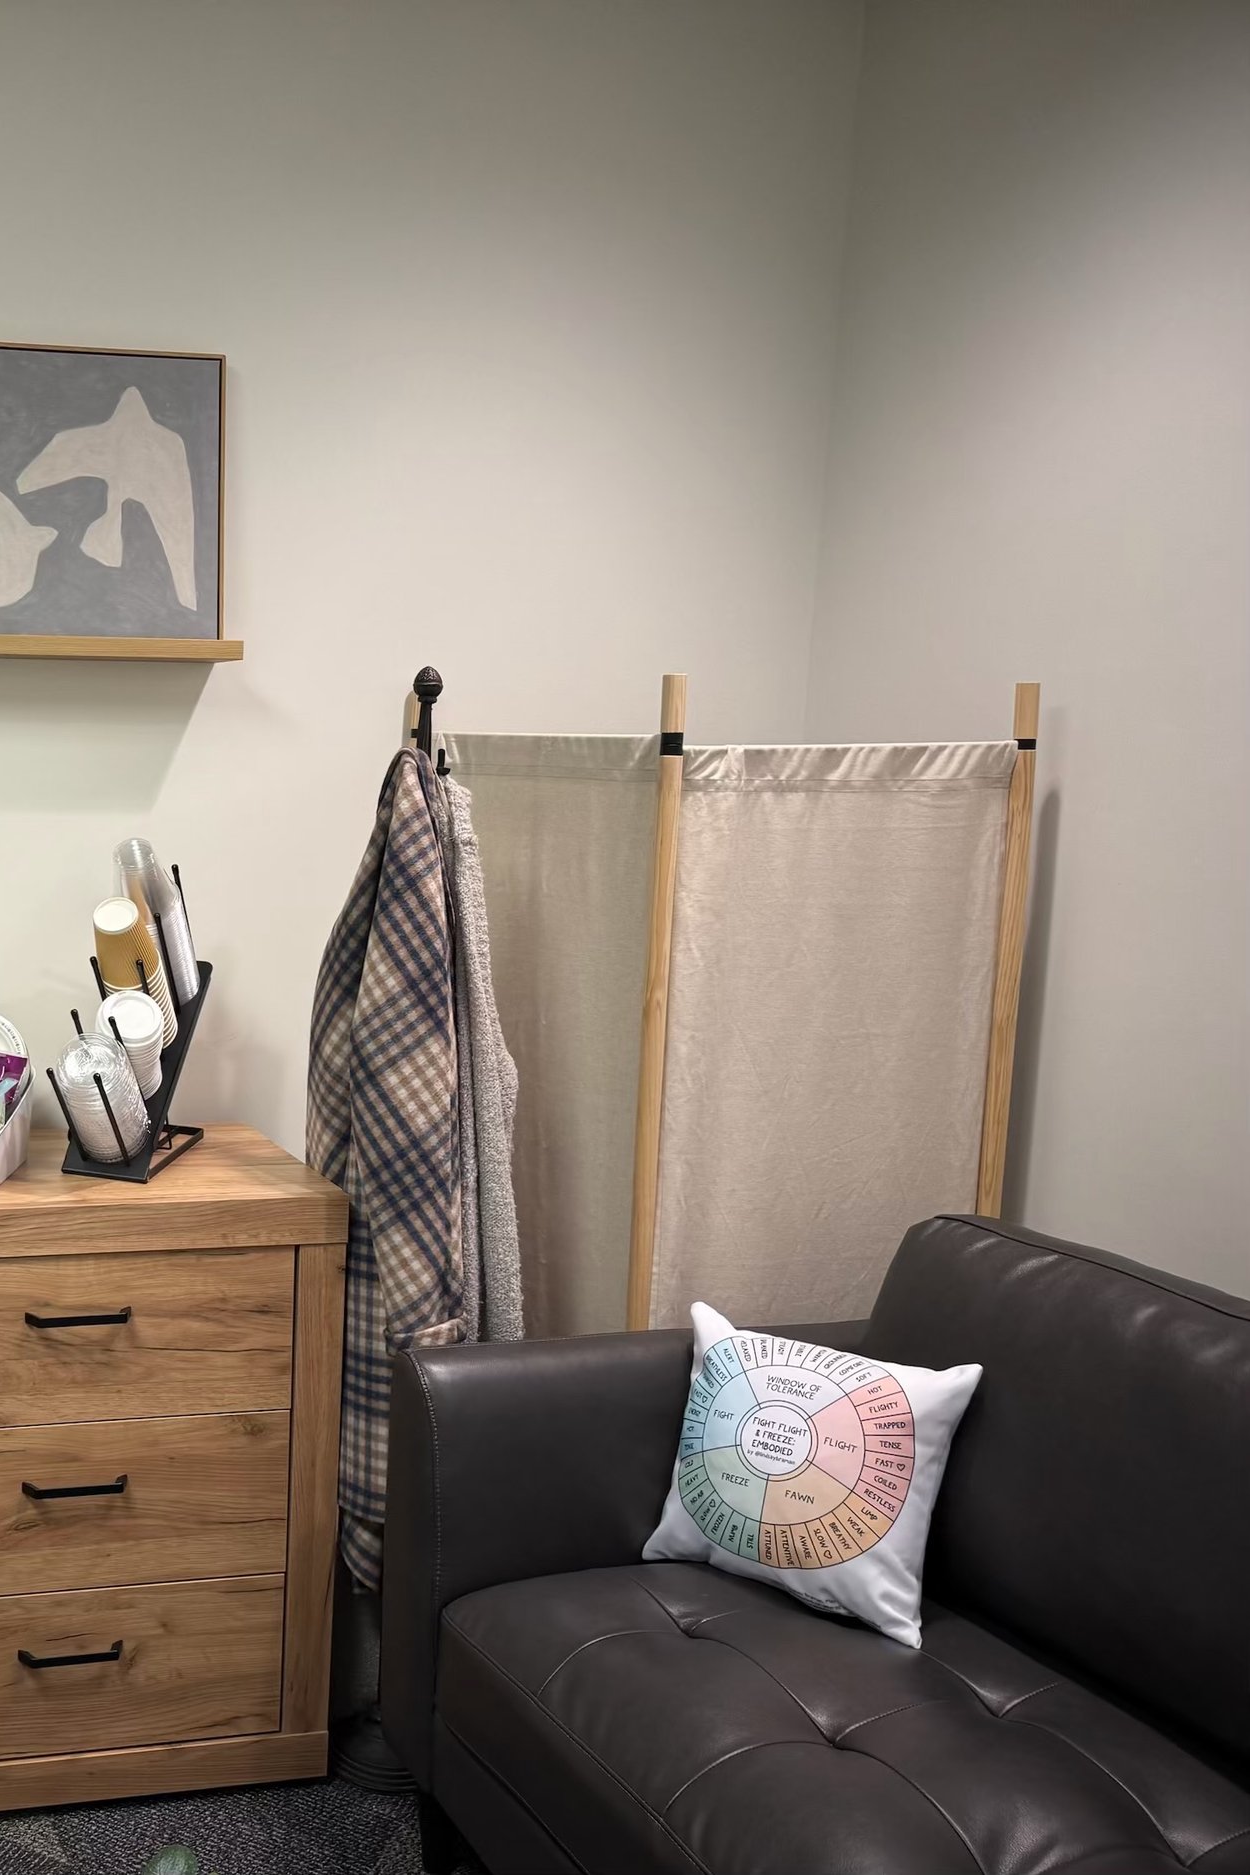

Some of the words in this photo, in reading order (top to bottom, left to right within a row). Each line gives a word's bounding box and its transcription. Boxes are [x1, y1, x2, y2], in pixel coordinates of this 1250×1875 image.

[723, 1348, 735, 1363] ALERT
[767, 1374, 808, 1389] WINDOW
[809, 1384, 823, 1393] OF
[855, 1371, 873, 1382] SOFT
[766, 1382, 817, 1400] TOLERANCE
[867, 1386, 883, 1395] HOT
[713, 1409, 735, 1420] FIGHT
[868, 1401, 899, 1414] FLIGHTY
[752, 1416, 777, 1430] FIGHT
[778, 1423, 808, 1437] FLIGHT
[874, 1421, 906, 1430] TRAPPED
[755, 1429, 761, 1437] &
[762, 1430, 796, 1446] FREEZE:
[823, 1436, 858, 1453] FLIGHT
[879, 1440, 902, 1450] TENSE
[751, 1438, 794, 1456] EMBODIED
[875, 1457, 894, 1469] FAST
[721, 1472, 751, 1487] FREEZE
[873, 1475, 898, 1491] COILED
[784, 1489, 815, 1504] FAWN
[863, 1488, 896, 1512] RESTLESS
[860, 1506, 878, 1521] LIMP
[711, 1512, 726, 1535] FROZEN
[847, 1516, 867, 1537] WEAK
[728, 1524, 739, 1542] NUMB
[746, 1533, 755, 1550] STILL
[813, 1528, 829, 1548] SLOW
[828, 1521, 852, 1550] BREATHY
[764, 1529, 772, 1560] ATTUNED
[780, 1529, 795, 1566] ATTENTIVE
[799, 1535, 813, 1560] AWARE
